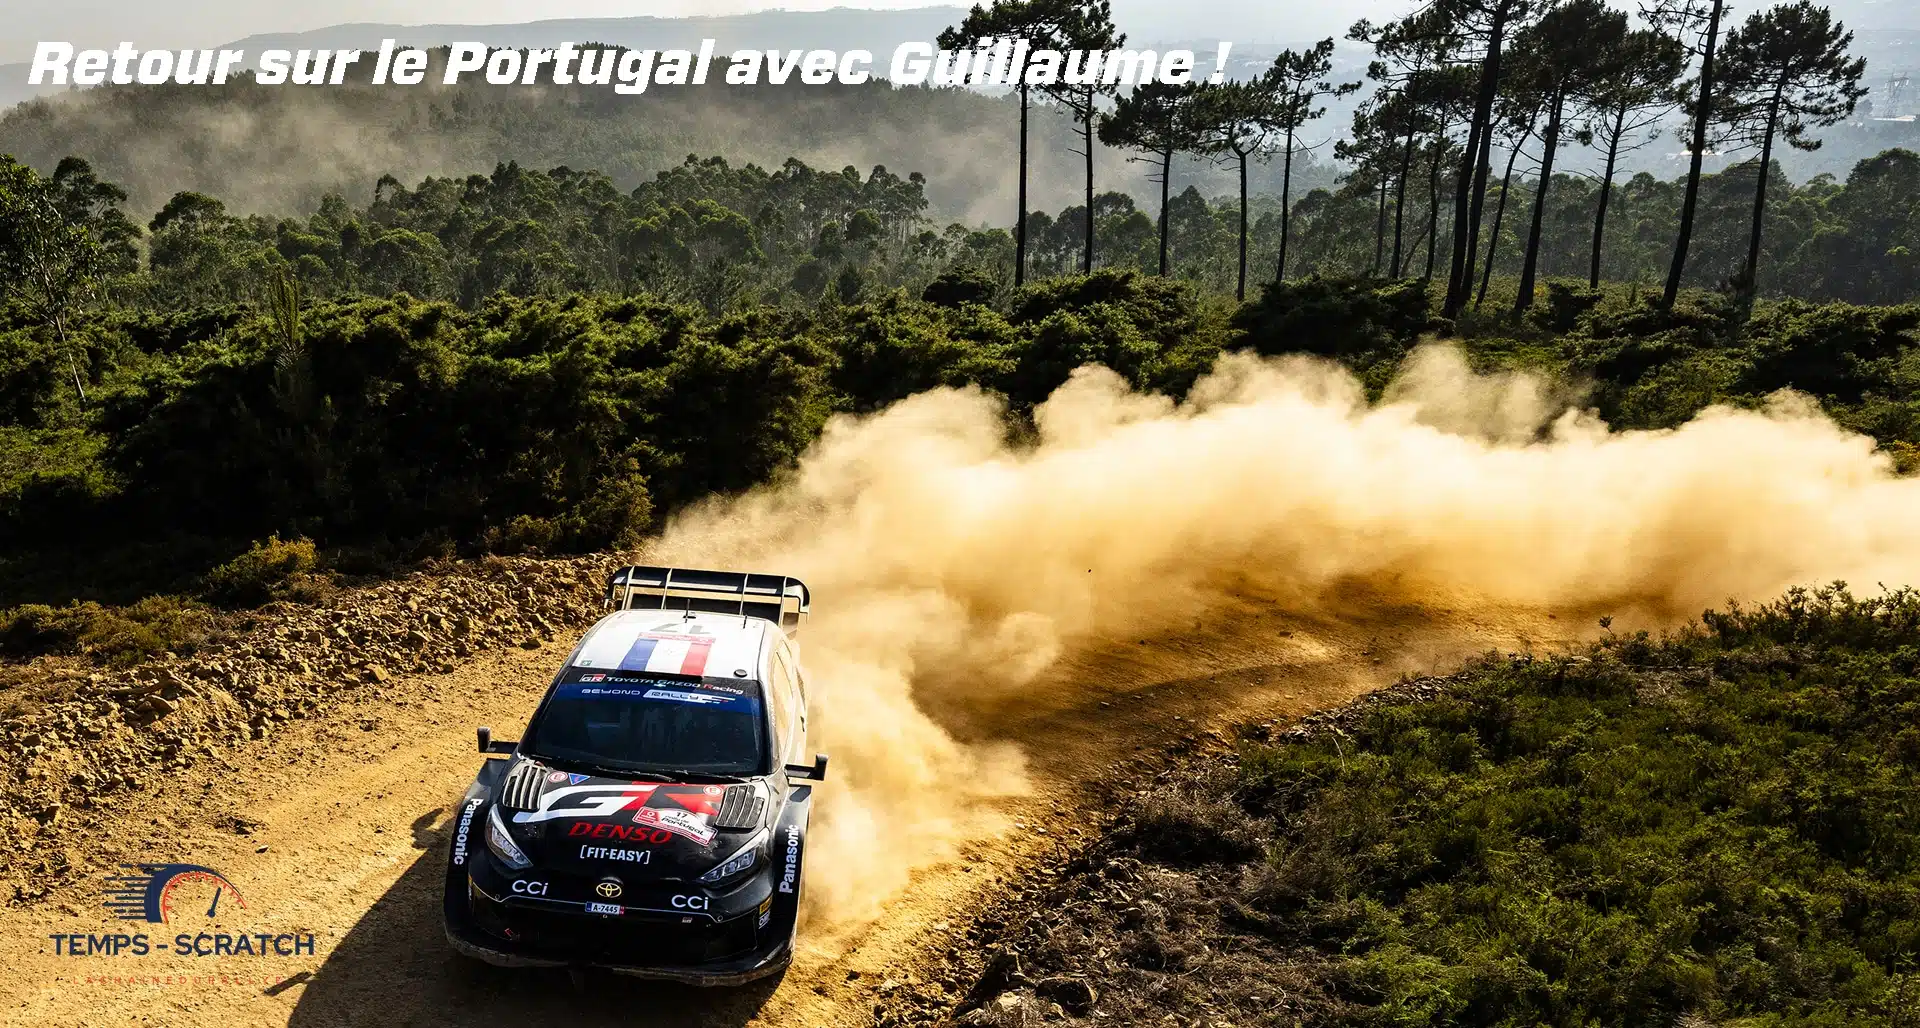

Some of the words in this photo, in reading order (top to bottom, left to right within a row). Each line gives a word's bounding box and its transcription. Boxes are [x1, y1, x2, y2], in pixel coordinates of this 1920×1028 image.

[581, 688, 641, 696] BEYOND
[650, 691, 699, 700] RALLY
[606, 676, 654, 684] TOYOTA
[656, 680, 700, 688] GAZOO
[703, 683, 744, 695] Racing
[454, 798, 485, 865] Panasonic
[568, 821, 673, 844] DENSO
[778, 824, 800, 894] Panasonic
[593, 904, 618, 913] A-7445
